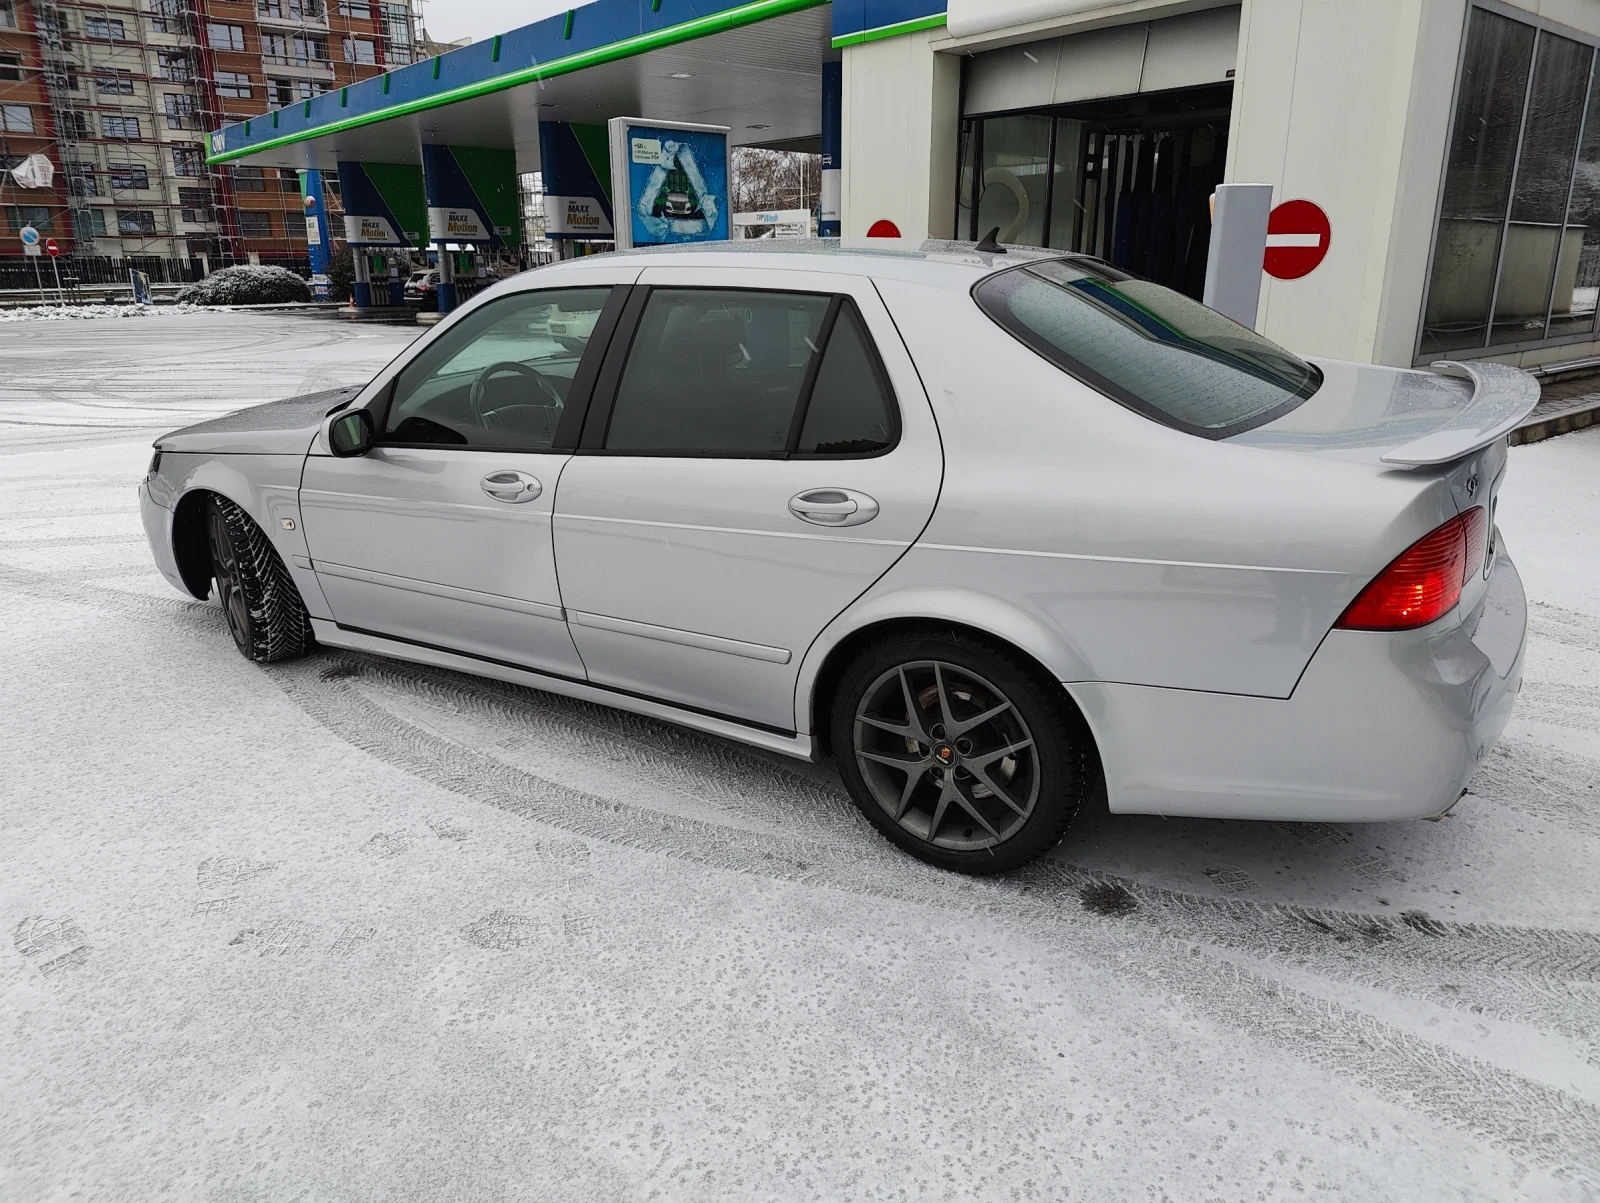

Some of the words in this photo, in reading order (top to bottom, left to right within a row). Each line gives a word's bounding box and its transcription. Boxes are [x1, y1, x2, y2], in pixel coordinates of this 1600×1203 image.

[212, 132, 226, 152] OMV
[568, 204, 589, 213] MAXX
[566, 214, 600, 225] Motion
[448, 222, 478, 232] Motion
